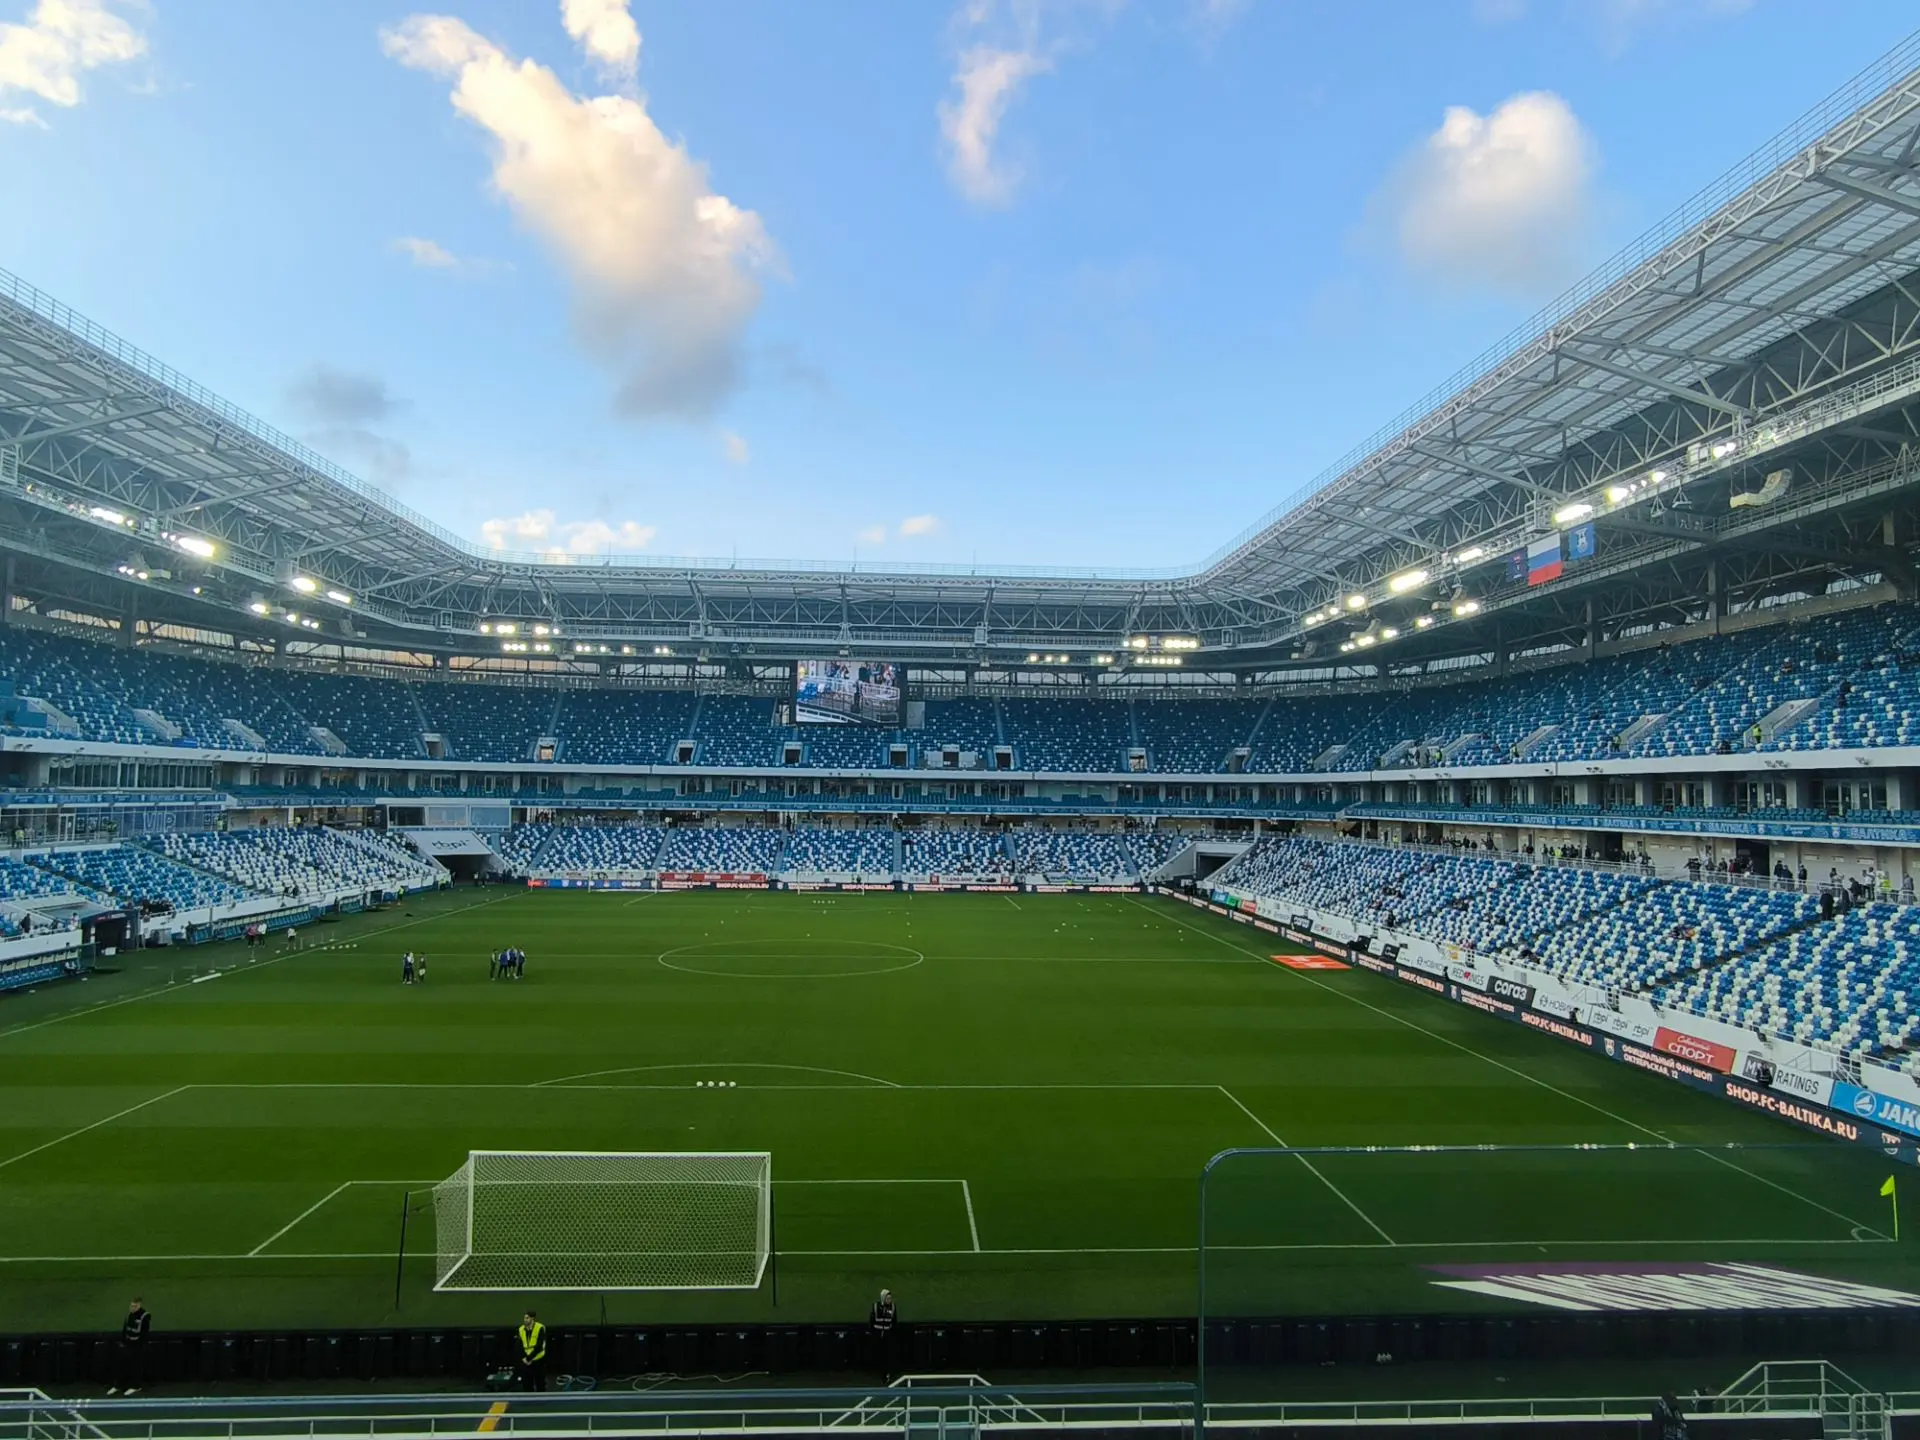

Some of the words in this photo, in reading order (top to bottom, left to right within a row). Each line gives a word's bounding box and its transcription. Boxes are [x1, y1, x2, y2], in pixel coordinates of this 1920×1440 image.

[143, 813, 177, 833] VIP
[1668, 1042, 1715, 1065] СПОРТ
[1776, 1069, 1819, 1095] RATINGS
[1726, 1082, 1858, 1140] SHOP.FC-BALTIKA.RU
